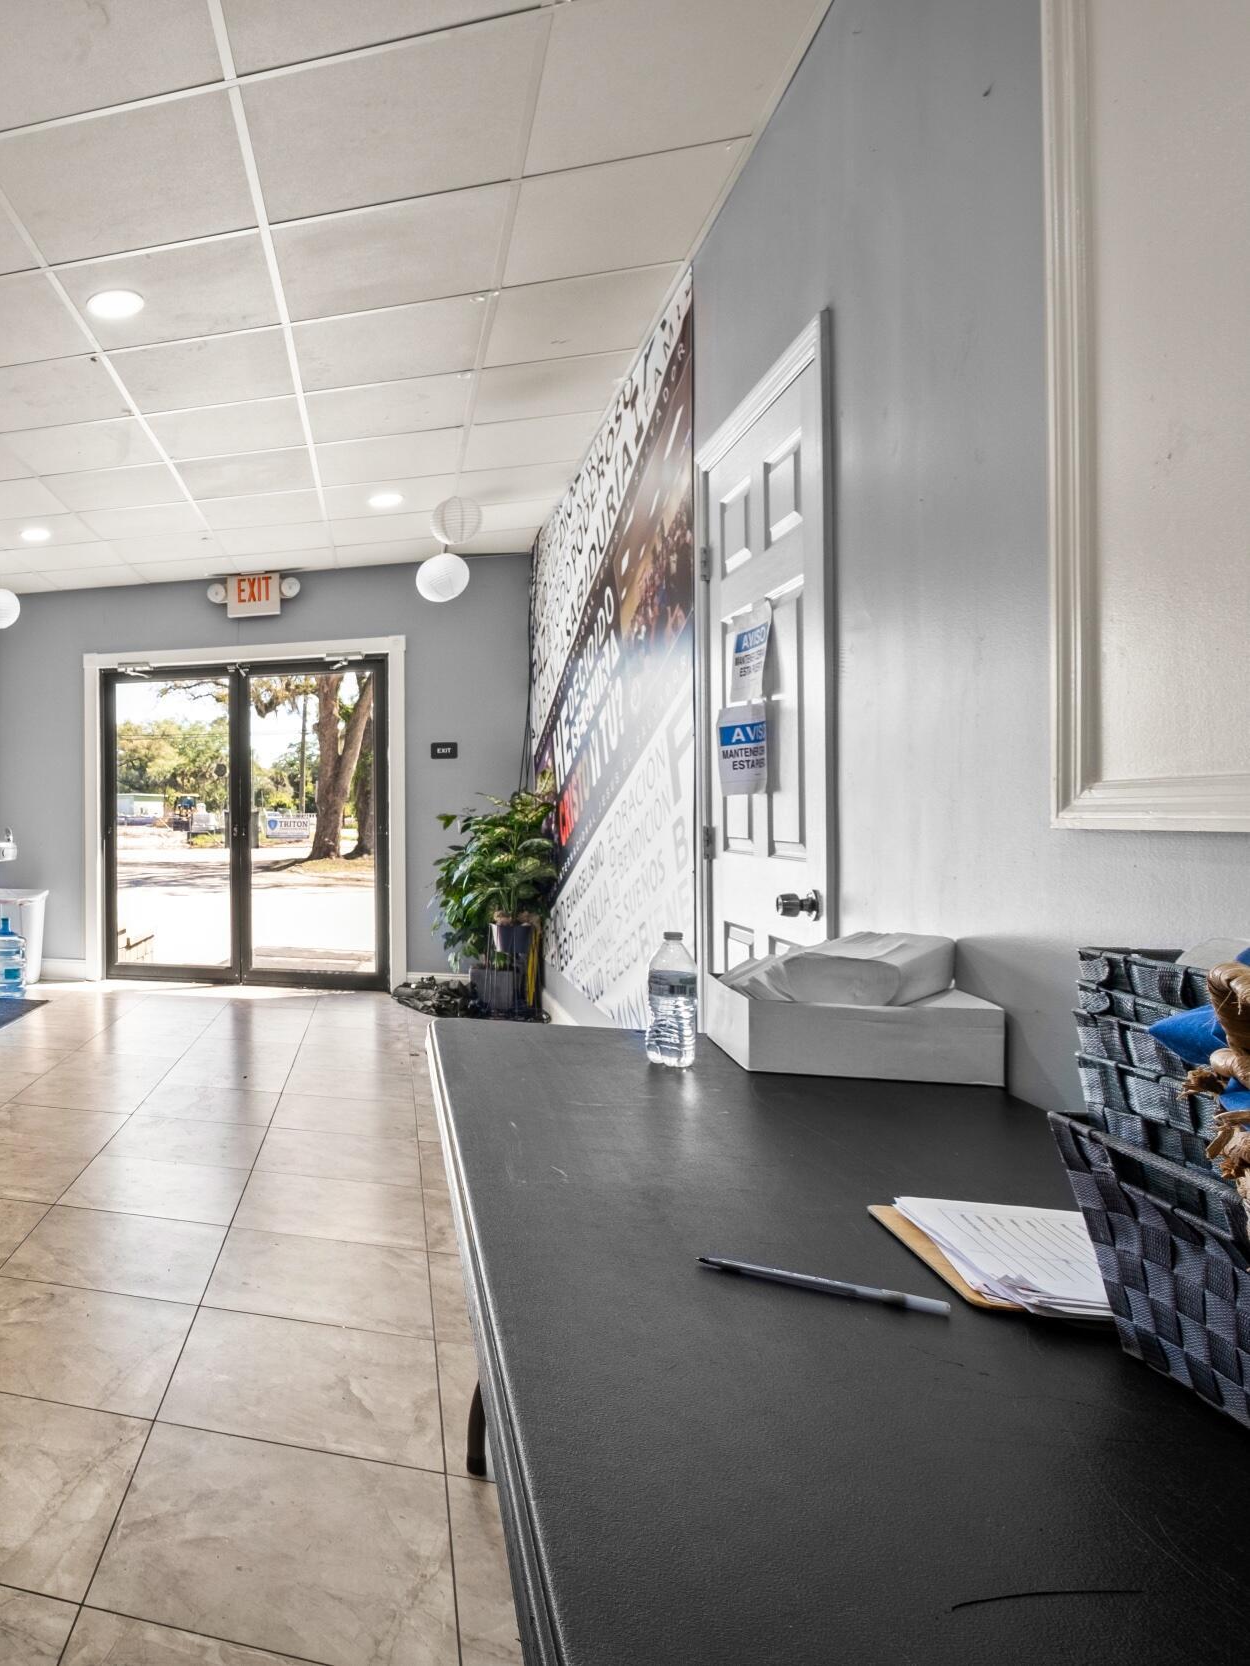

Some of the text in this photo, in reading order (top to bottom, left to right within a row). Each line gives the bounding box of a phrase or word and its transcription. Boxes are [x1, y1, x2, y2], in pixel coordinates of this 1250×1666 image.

[237, 576, 272, 603] EXIT
[742, 627, 766, 650] AVISO
[552, 704, 572, 794] HE
[279, 820, 308, 828] TRITON
[558, 754, 590, 846] CRISTO
[566, 840, 604, 919] EVANGELISMO
[574, 879, 612, 947] FAMILIA
[623, 846, 666, 920] SUEÑOS
[606, 930, 639, 983] FUEGO
